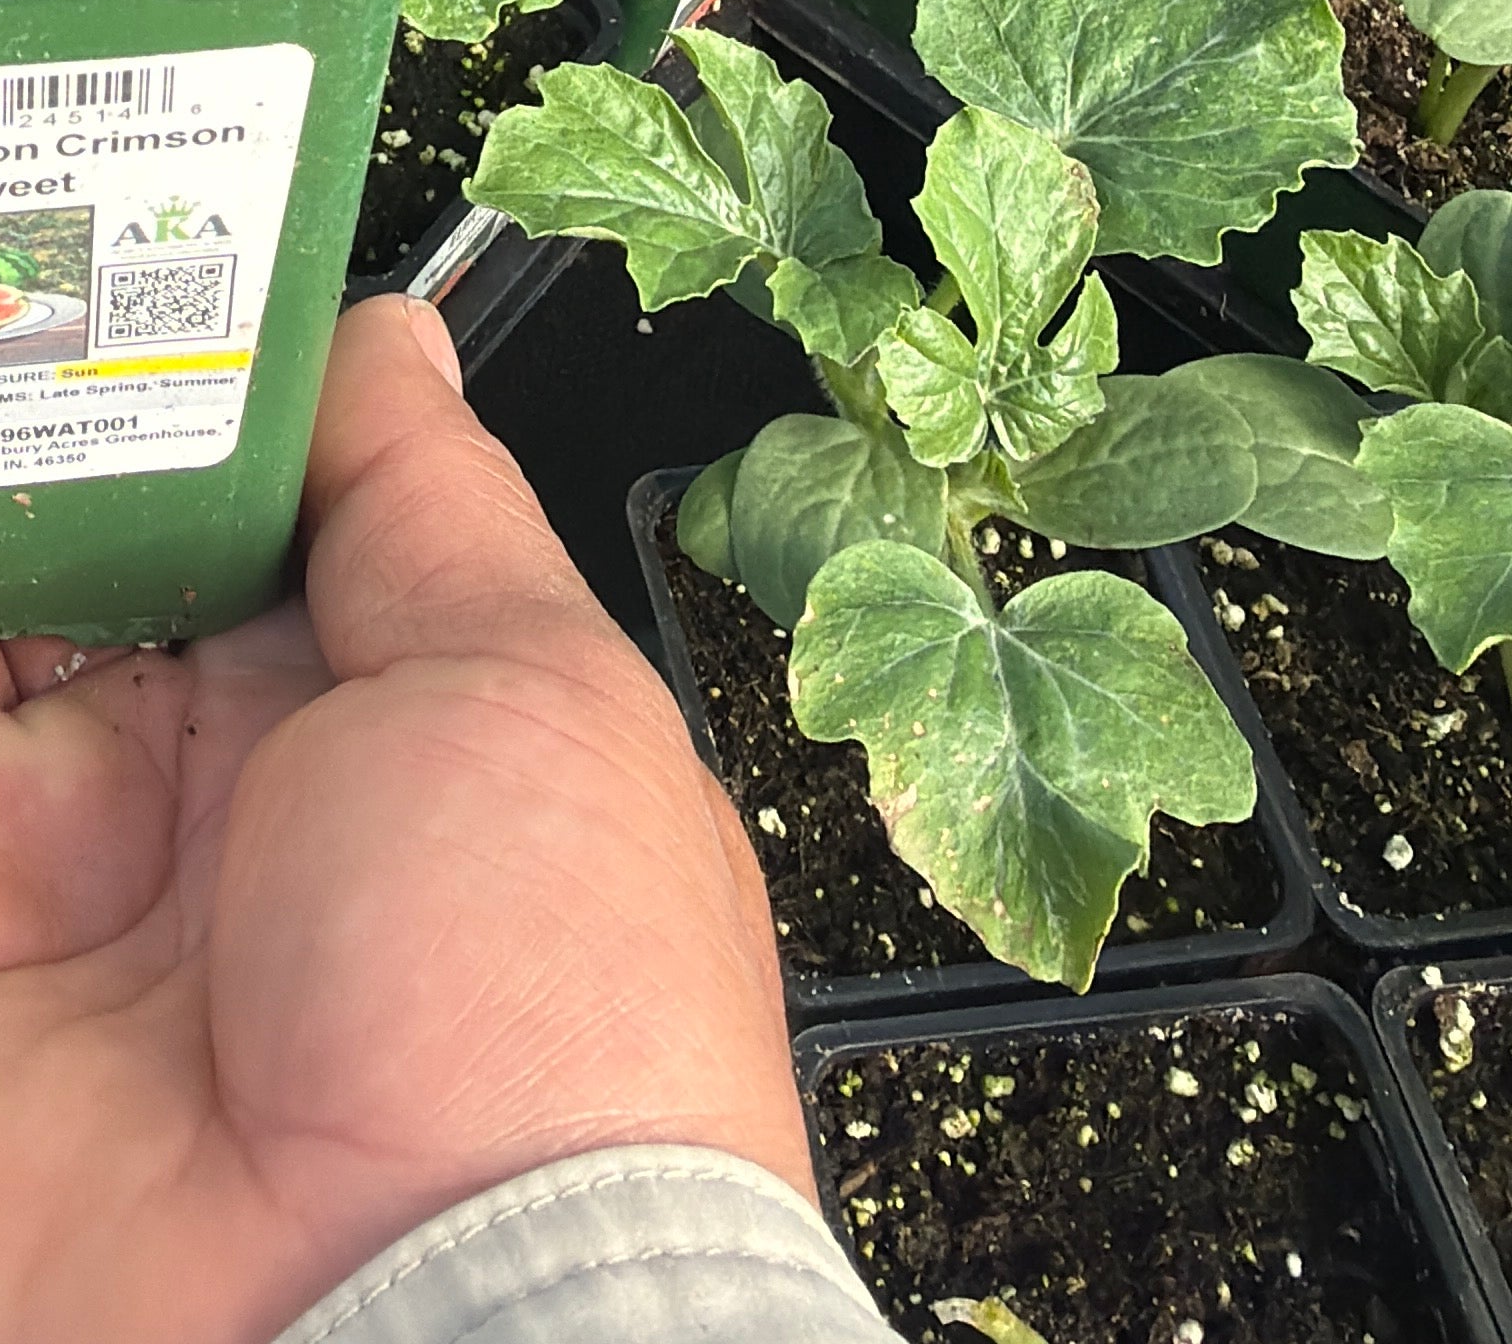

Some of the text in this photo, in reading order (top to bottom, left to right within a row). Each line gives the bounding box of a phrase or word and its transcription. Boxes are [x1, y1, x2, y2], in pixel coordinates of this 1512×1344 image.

[55, 125, 246, 157] Crimson
[110, 213, 233, 248] AKA
[61, 367, 99, 379] Sun
[40, 389, 80, 401] Late
[159, 376, 237, 388] Summer
[47, 437, 100, 452] Acres
[34, 453, 87, 468] 46350
